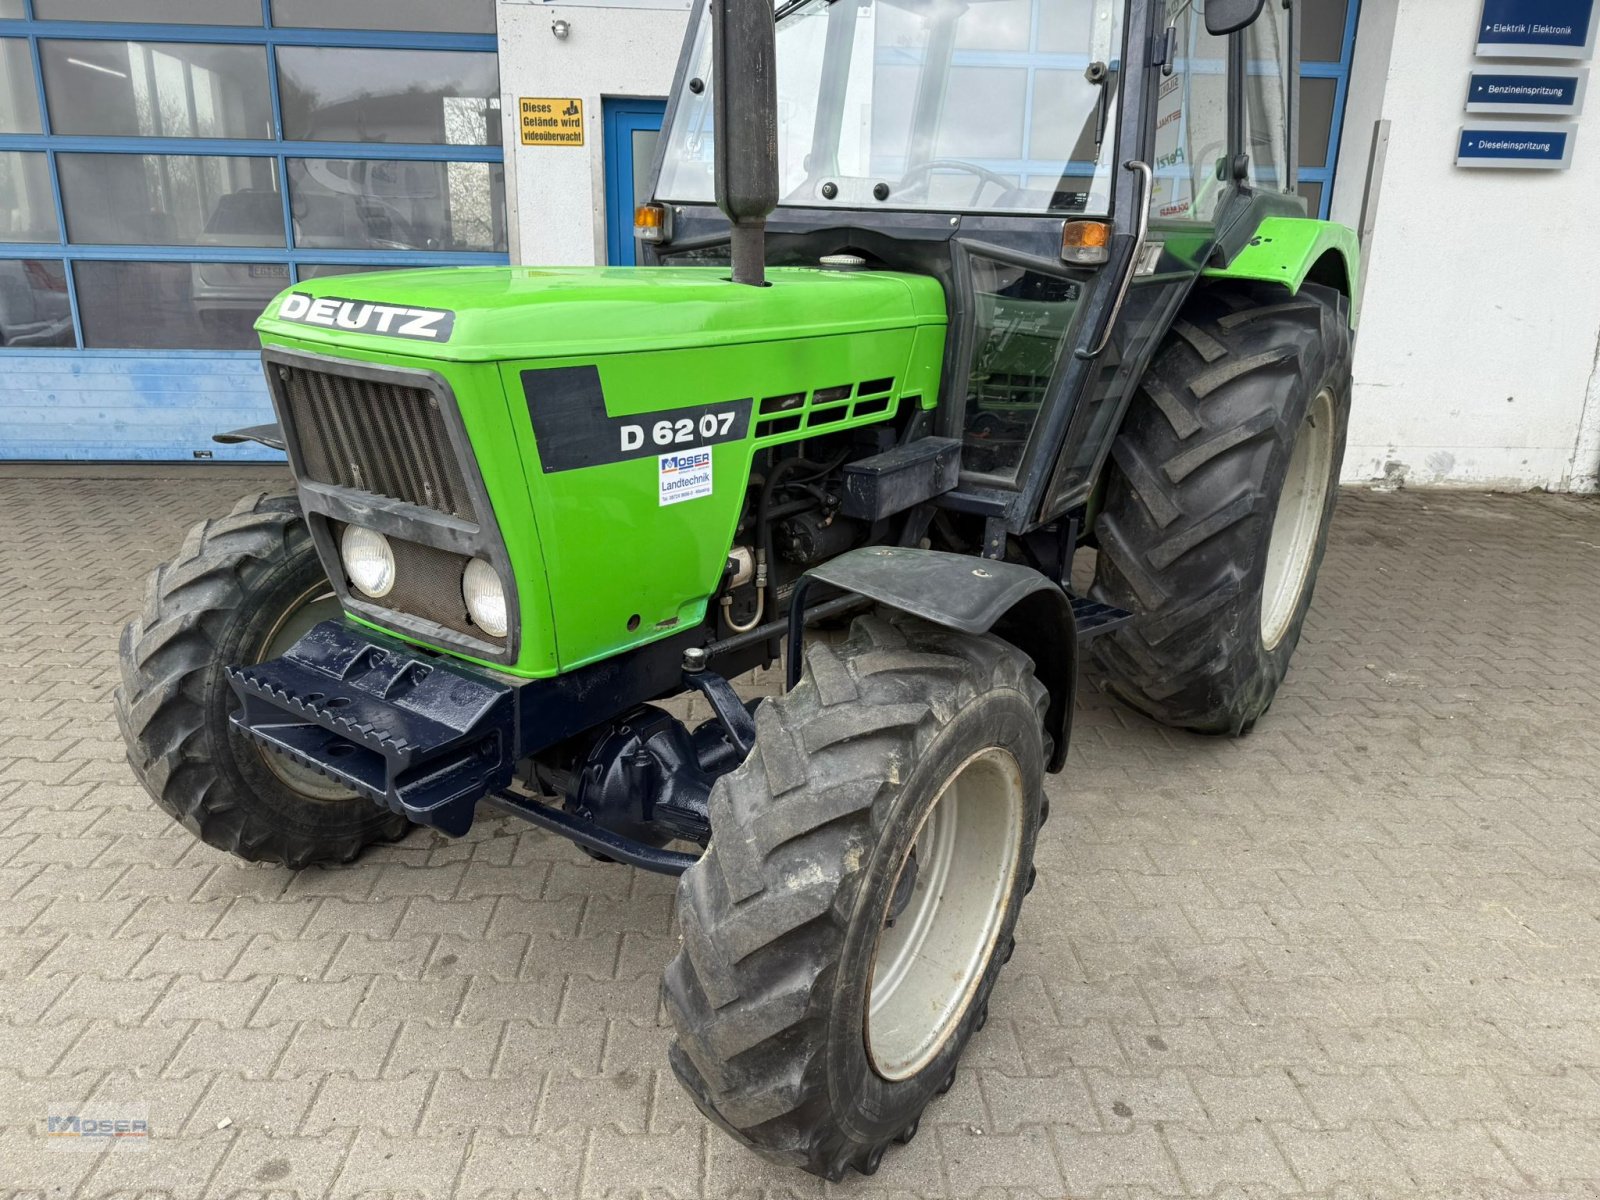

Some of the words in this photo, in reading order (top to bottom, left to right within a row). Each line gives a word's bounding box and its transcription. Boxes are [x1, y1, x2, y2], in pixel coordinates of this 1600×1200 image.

[1493, 23, 1526, 33] Elektrik
[1532, 24, 1572, 35] Elektronik
[1488, 84, 1563, 97] Benzineinspritzung
[522, 102, 552, 113] Dieses
[523, 116, 558, 127] Gelände
[560, 117, 580, 128] wird
[524, 130, 581, 142] videoüberwacht
[1478, 140, 1550, 152] Dieseleinspritzung
[278, 293, 446, 338] DEUTZ
[620, 424, 645, 452] D
[661, 452, 710, 470] MOSER
[661, 472, 710, 492] Landtechnik
